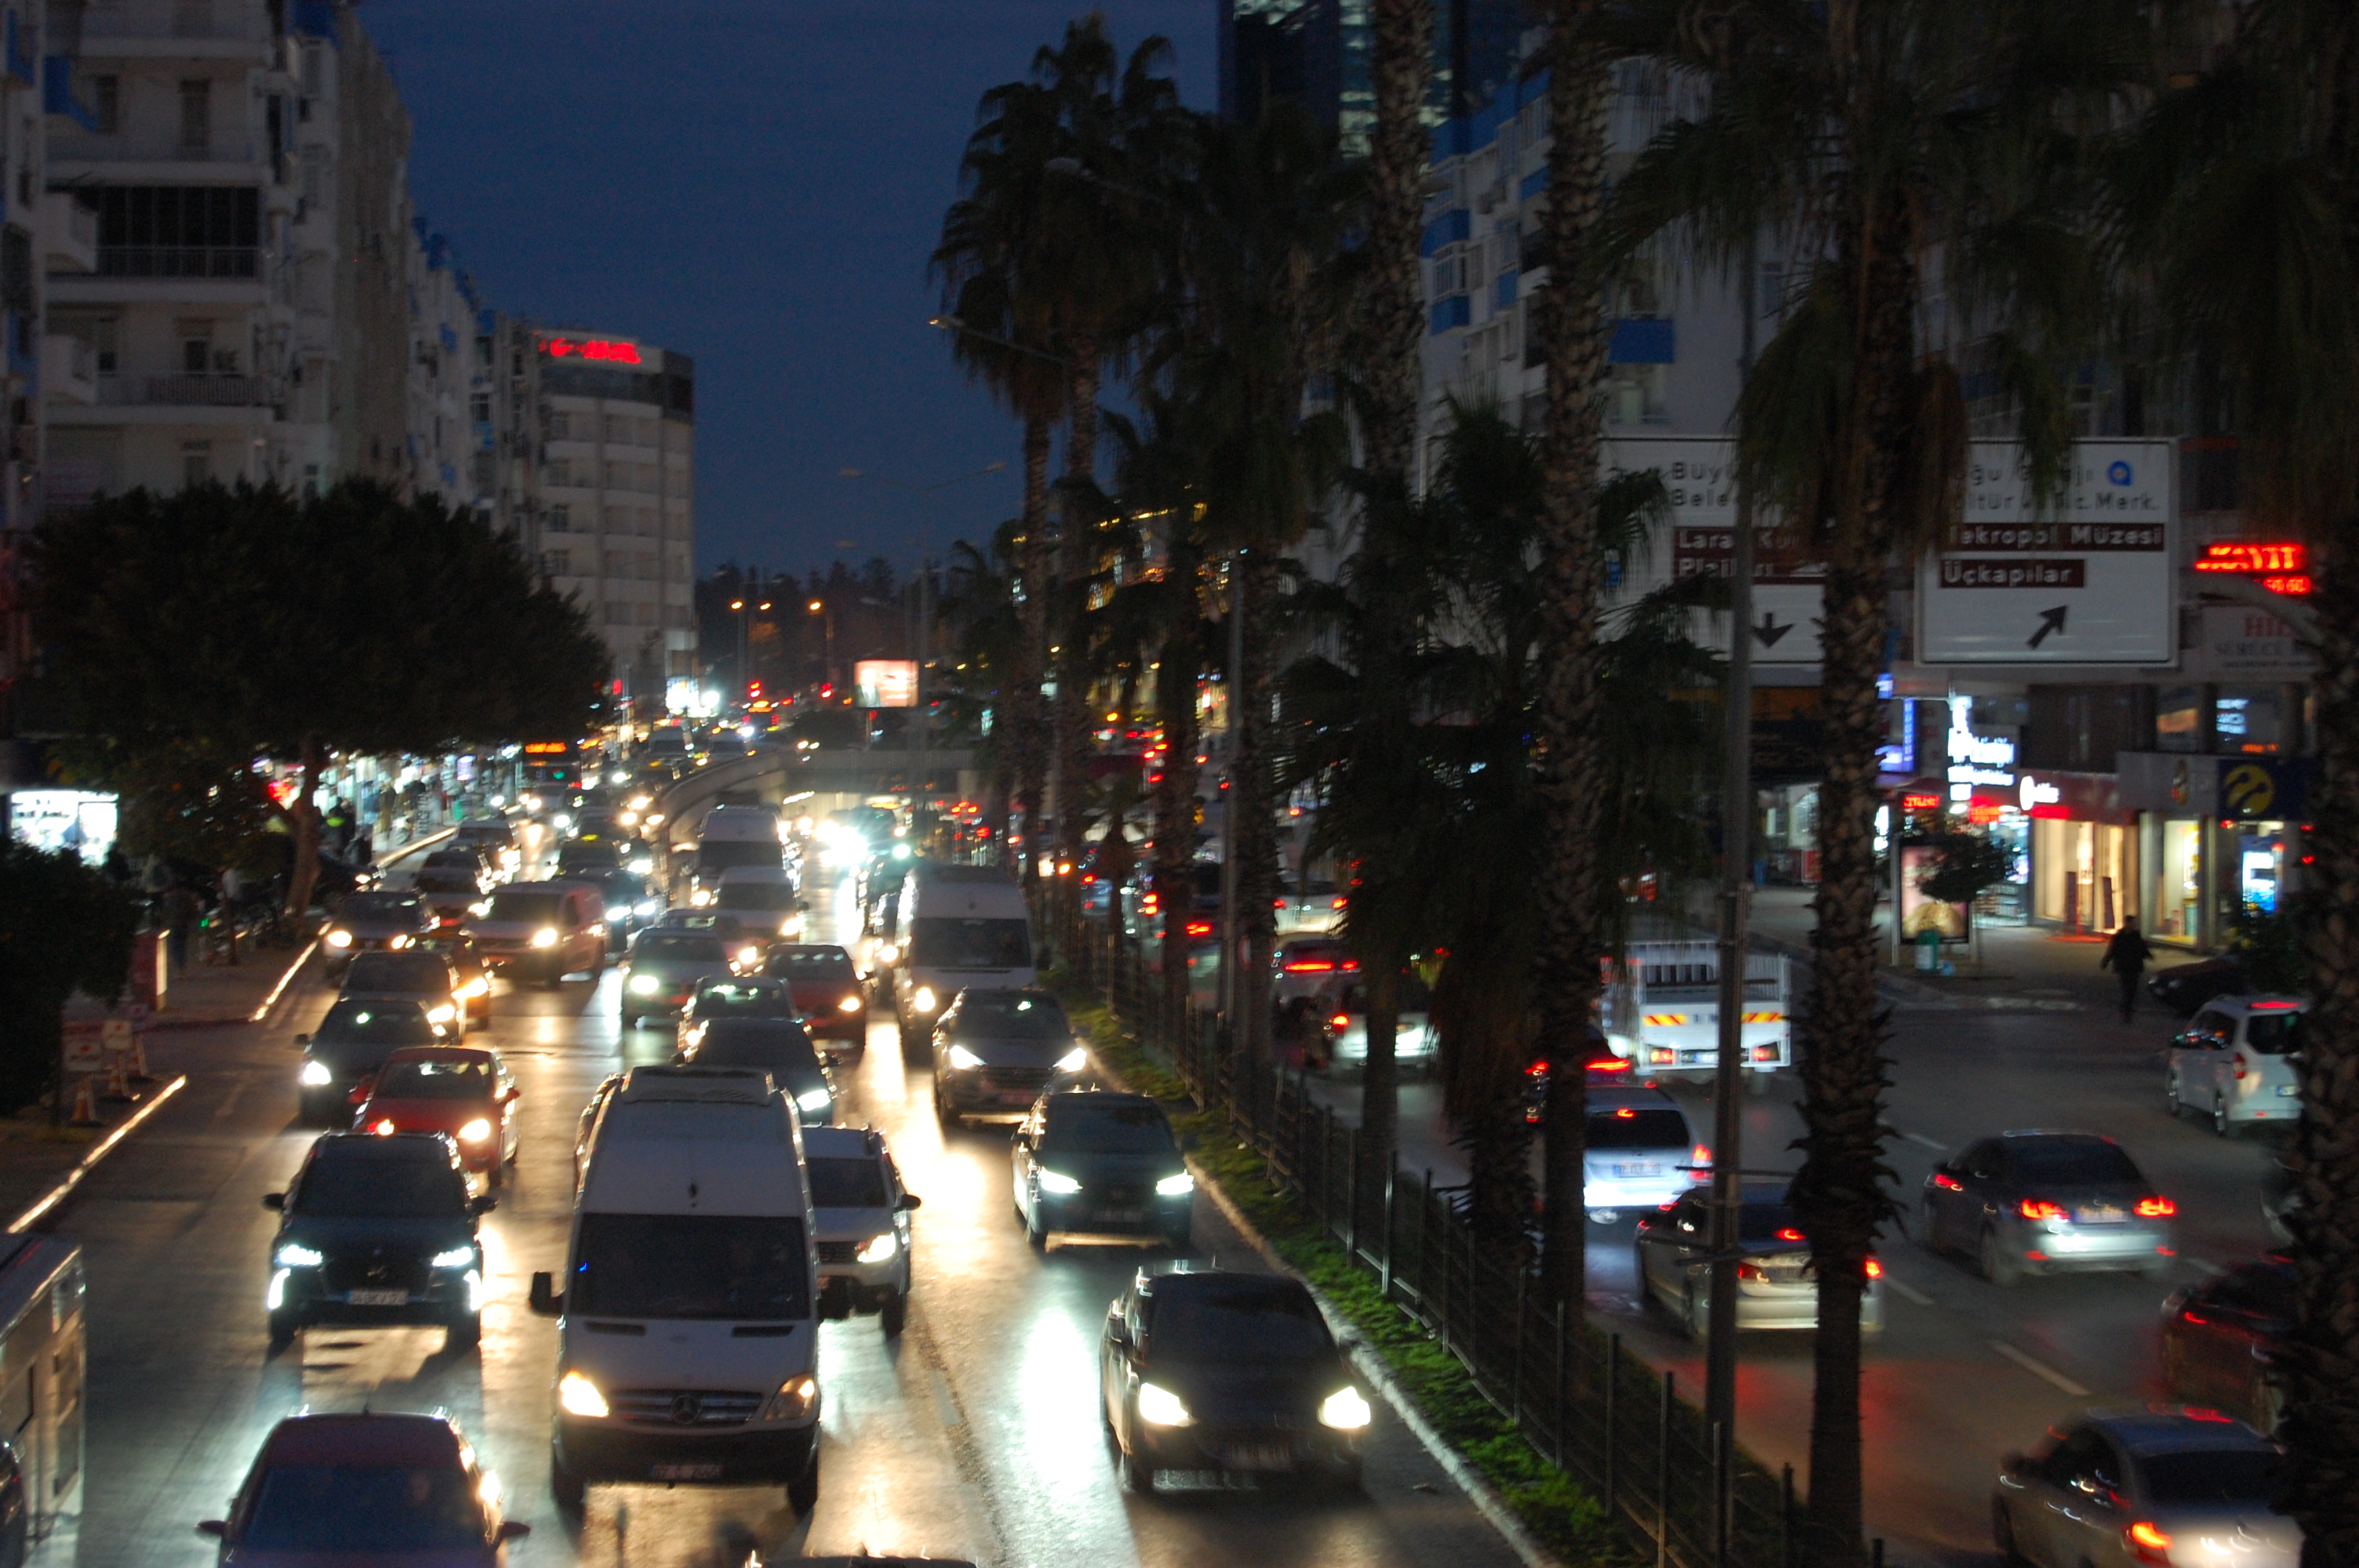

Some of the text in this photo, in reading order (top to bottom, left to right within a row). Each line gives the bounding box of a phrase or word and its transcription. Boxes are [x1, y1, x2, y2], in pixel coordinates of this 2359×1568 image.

[1678, 528, 1736, 549] Lara
[2070, 524, 2164, 545] Müzesi
[1943, 559, 2073, 587] Üçkapılar
